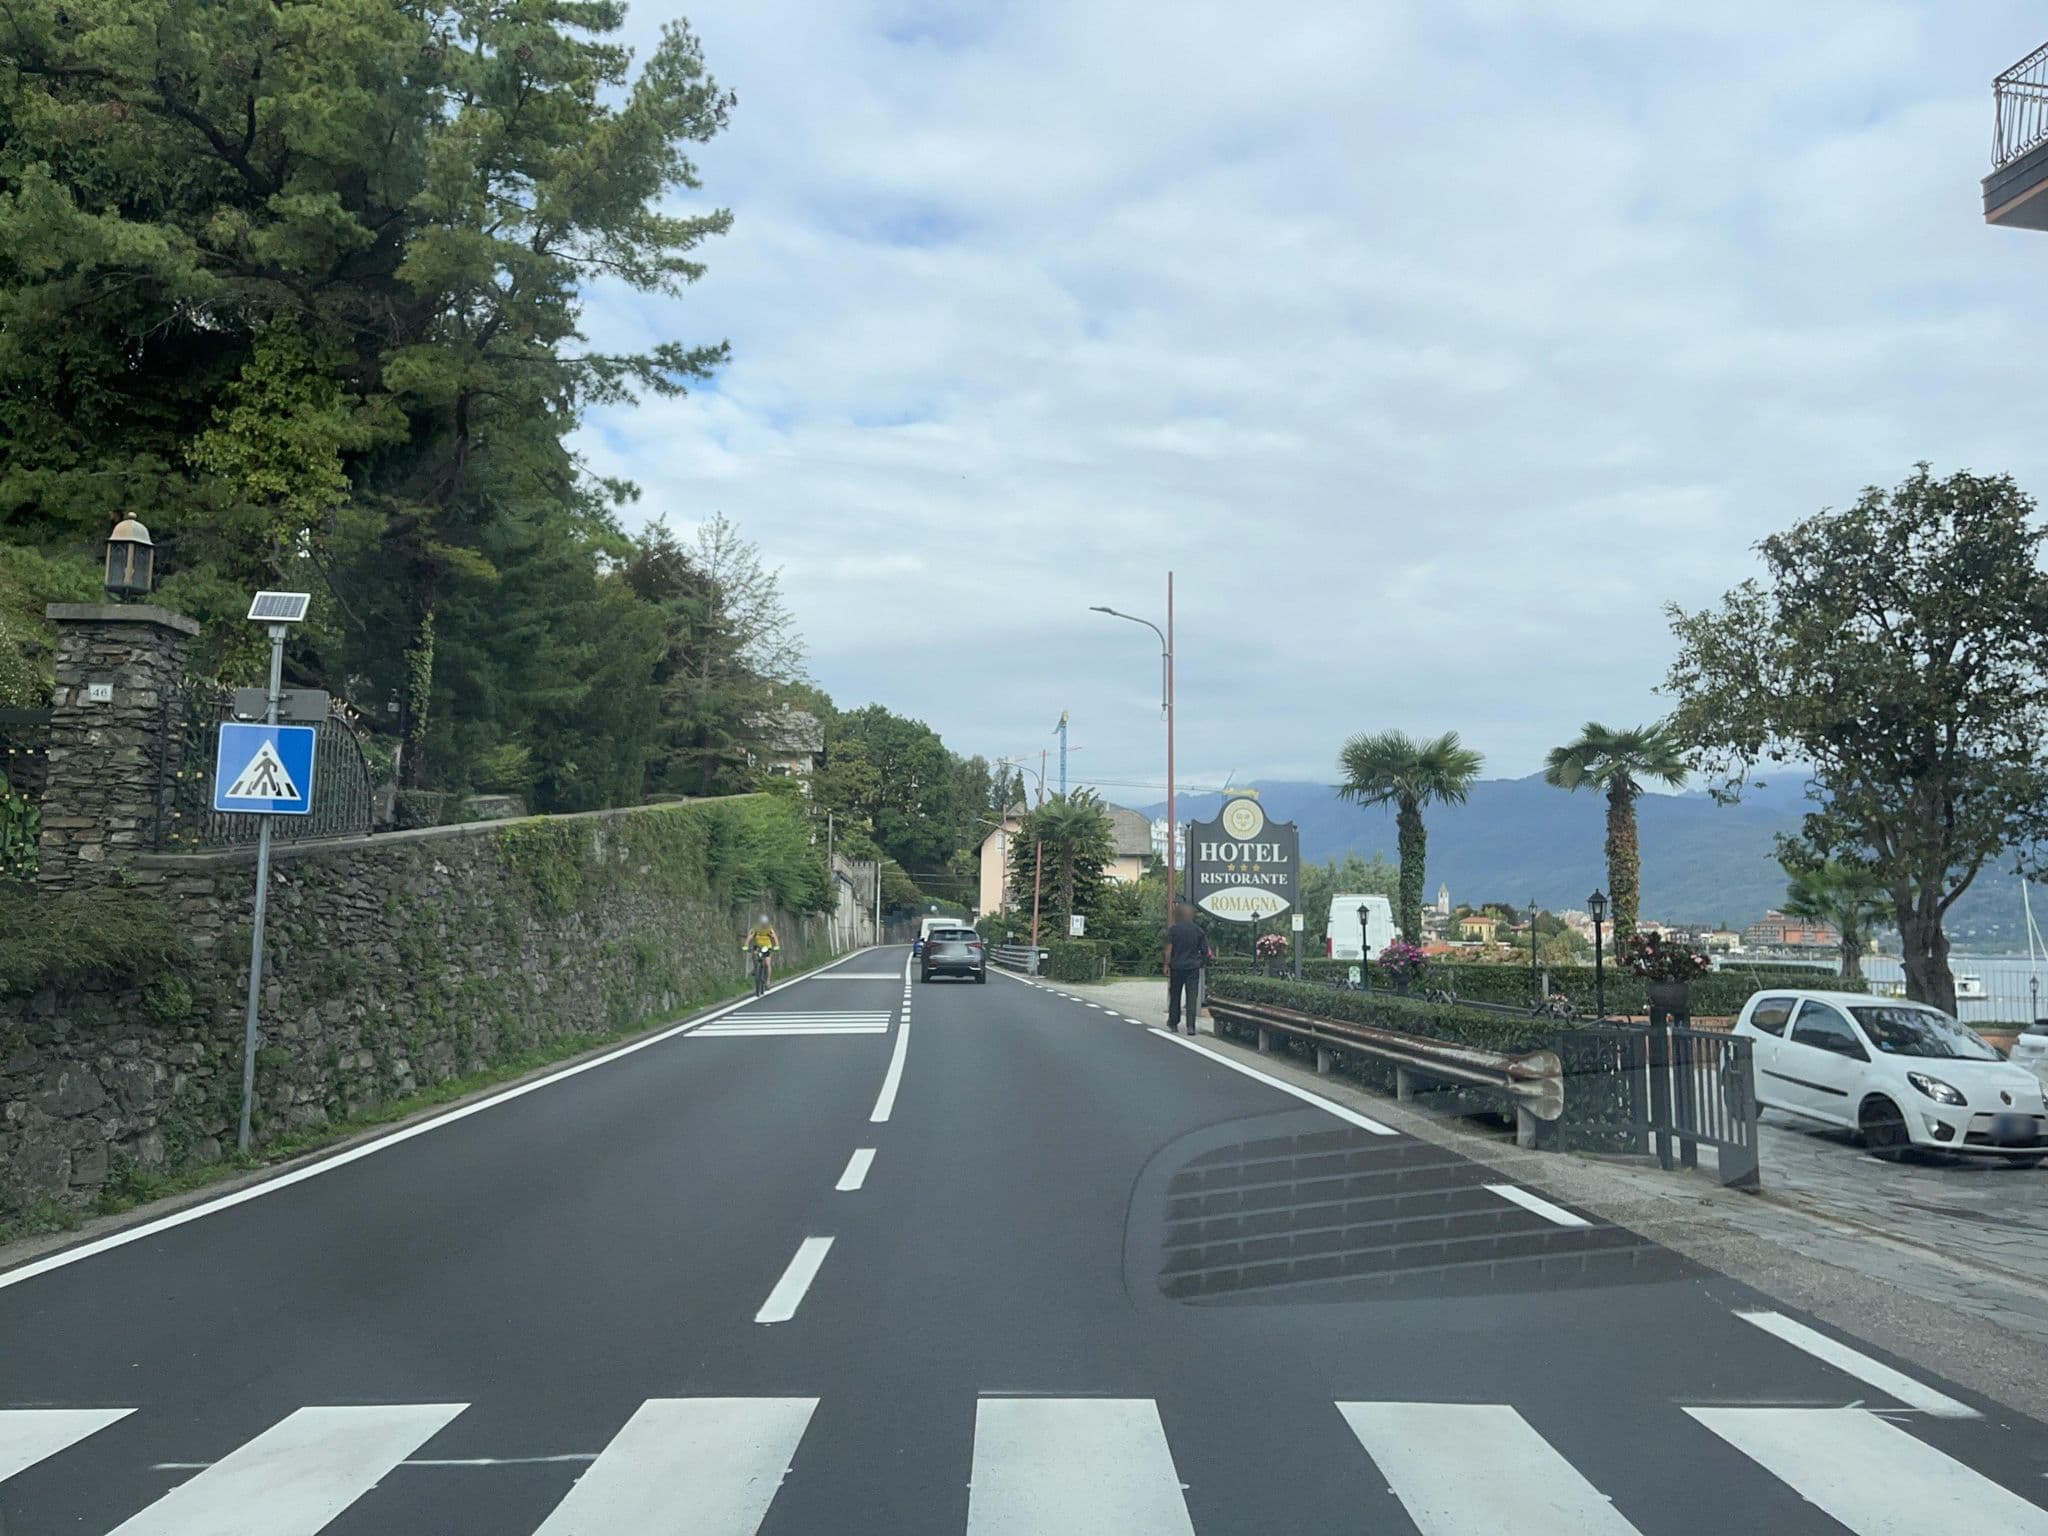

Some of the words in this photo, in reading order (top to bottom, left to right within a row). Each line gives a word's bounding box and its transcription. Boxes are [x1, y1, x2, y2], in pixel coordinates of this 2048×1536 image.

[1199, 842, 1288, 863] HOTEL
[1200, 872, 1288, 885] RISTORANTE
[1210, 896, 1278, 912] ROMAGNA
